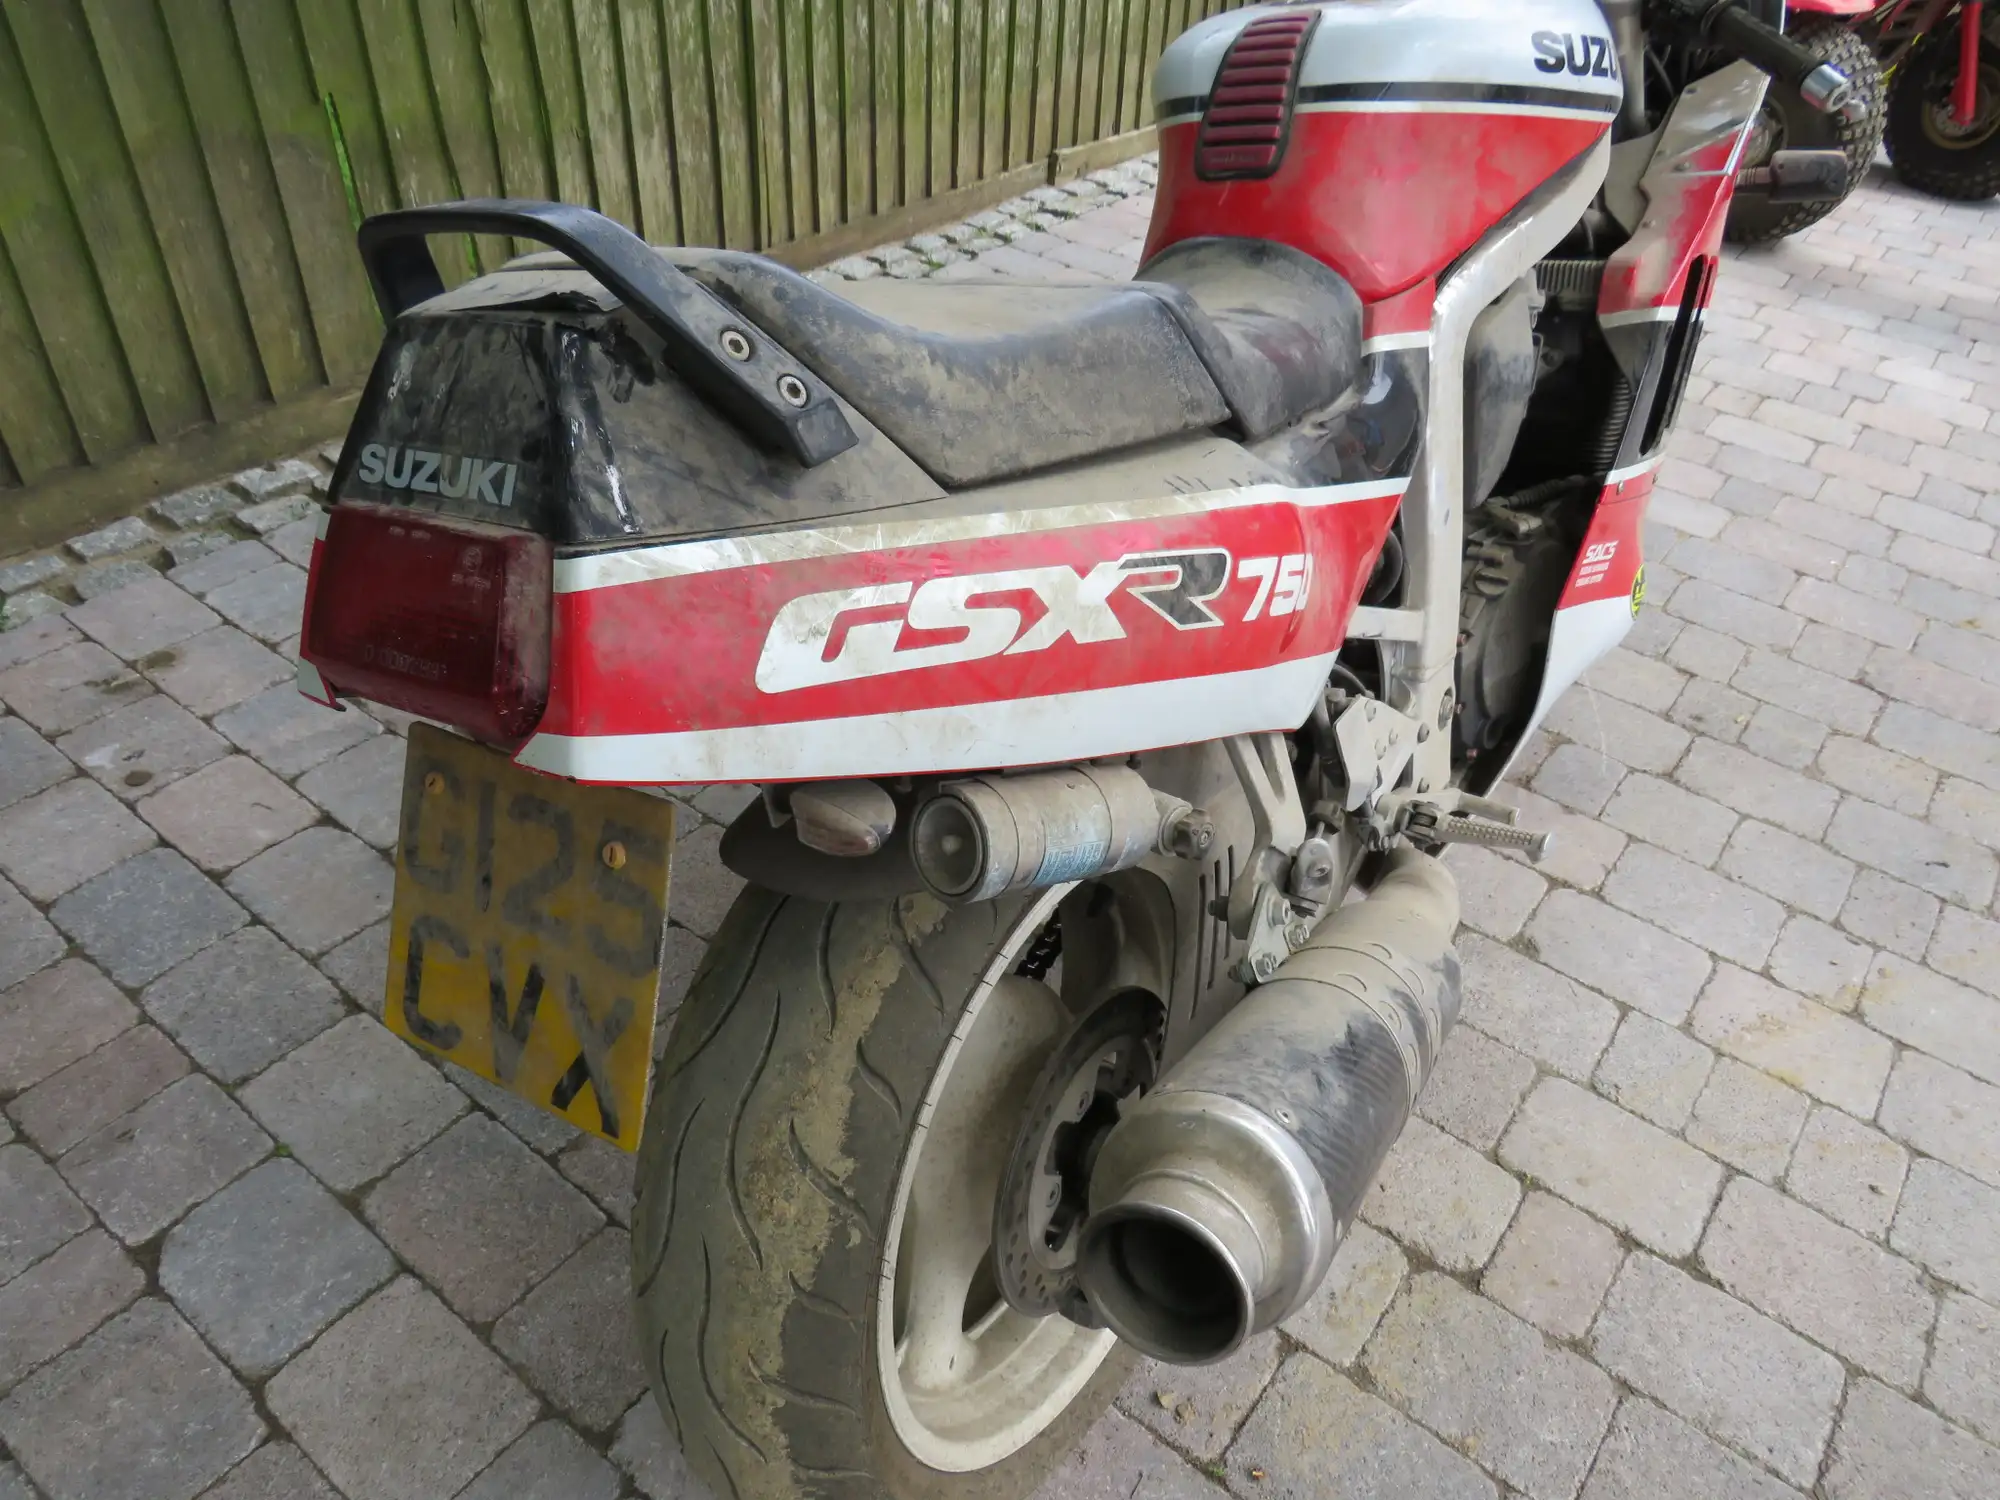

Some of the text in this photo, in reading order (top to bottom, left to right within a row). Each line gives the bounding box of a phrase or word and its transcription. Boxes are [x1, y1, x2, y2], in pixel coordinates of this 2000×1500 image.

[359, 443, 517, 506] SUZUKI
[1582, 540, 1619, 564] SACS
[754, 547, 1313, 694] GSXR 750
[403, 914, 635, 1139] CVX
